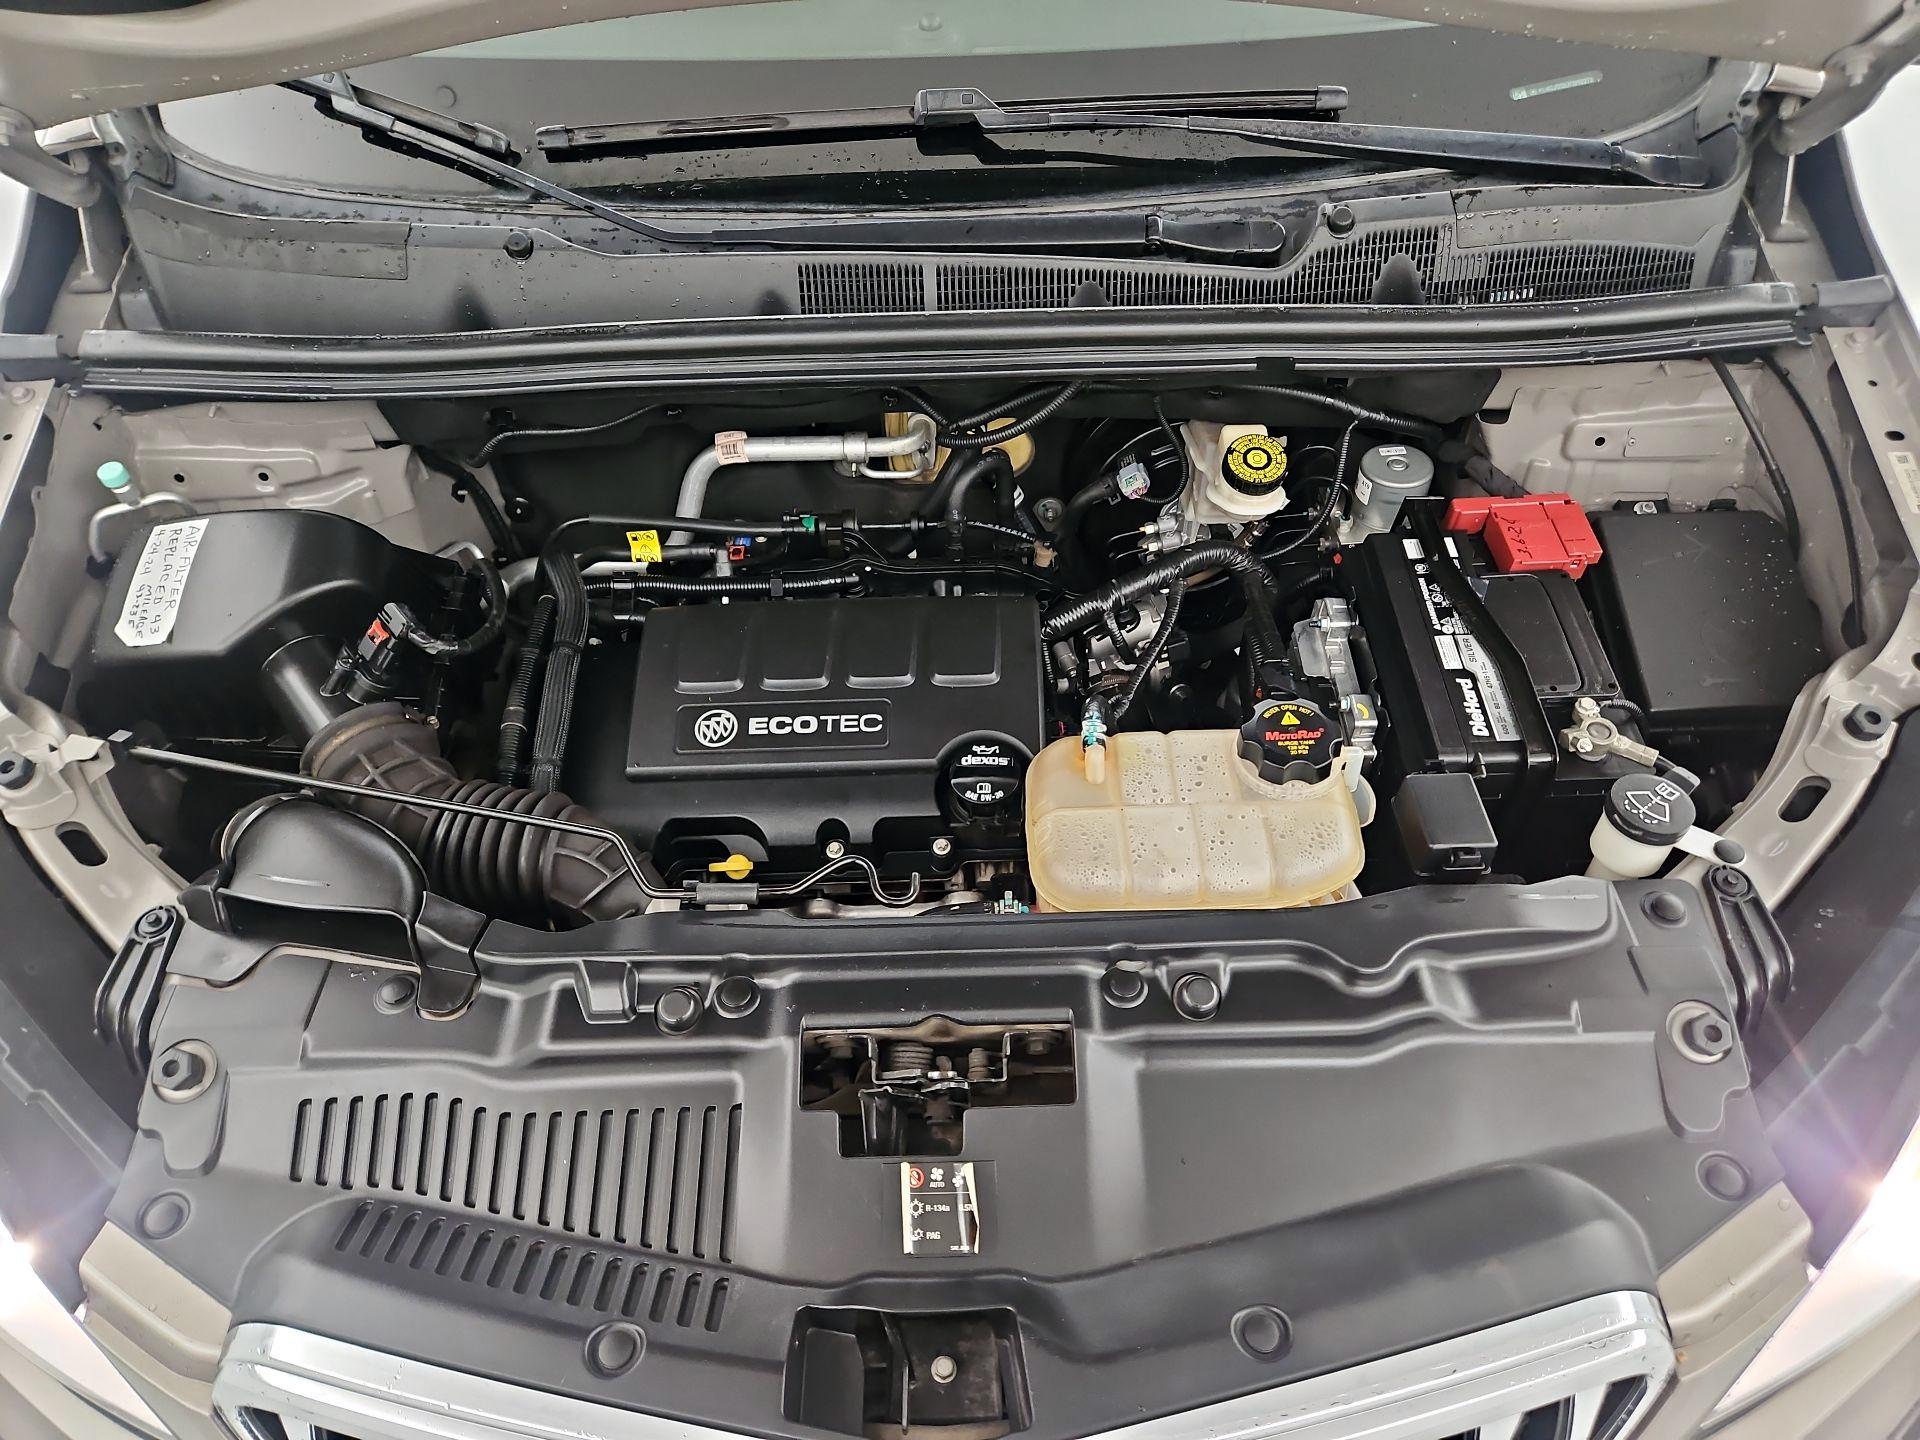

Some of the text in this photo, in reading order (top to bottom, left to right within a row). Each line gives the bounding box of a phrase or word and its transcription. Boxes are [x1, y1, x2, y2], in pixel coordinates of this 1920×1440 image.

[154, 528, 182, 605] REPLACED
[136, 584, 152, 638] MILEAGE
[1463, 638, 1478, 663] SILVER
[1263, 706, 1280, 719] NEVER
[1456, 678, 1490, 737] DieHard
[748, 714, 883, 735] ECOTEC
[961, 754, 1009, 766] dexos
[965, 790, 1005, 802] SAE 5W-30
[925, 1204, 951, 1212] R-134a
[926, 1231, 941, 1240] PAG
